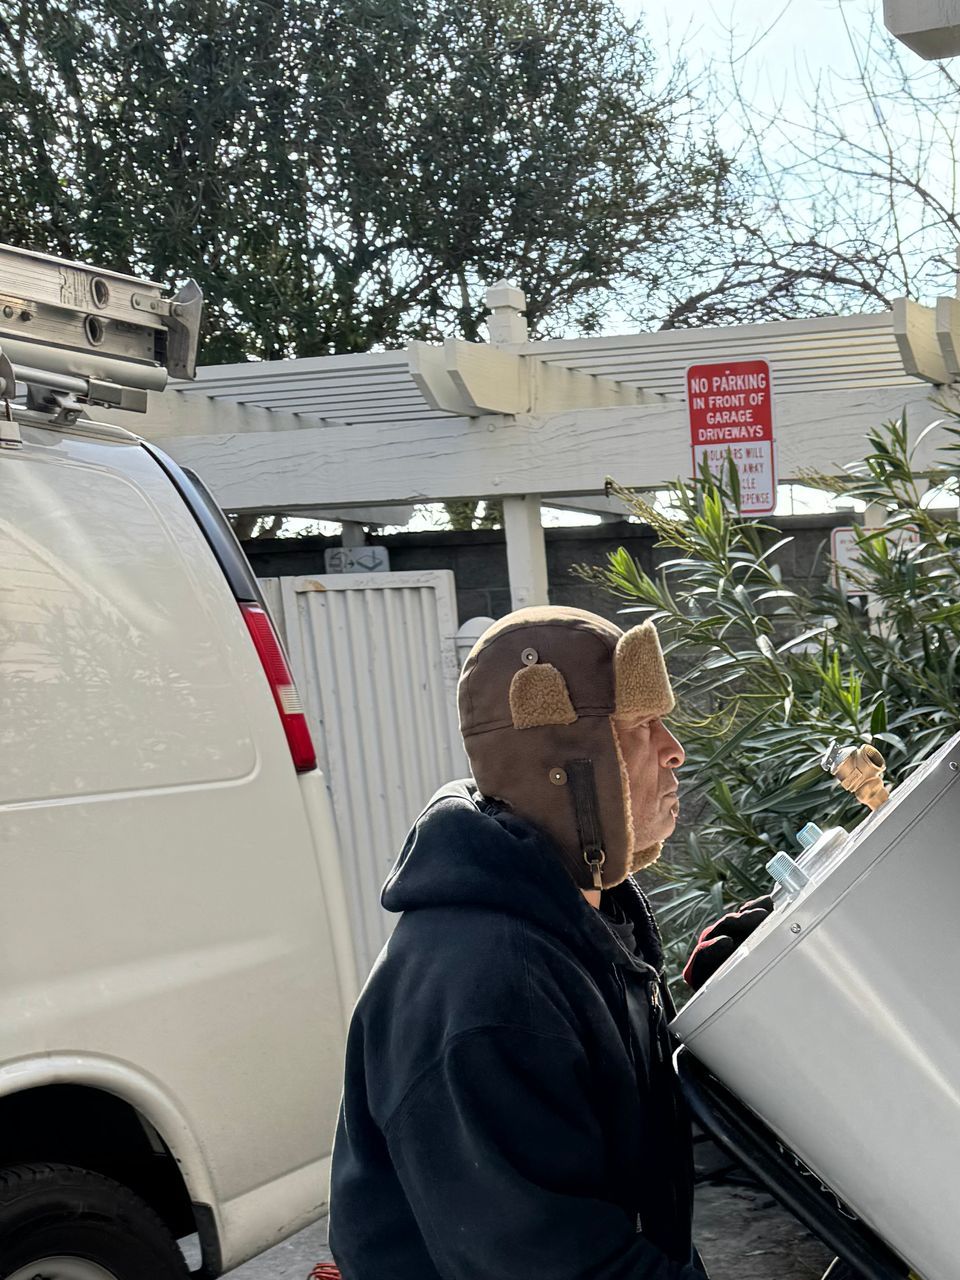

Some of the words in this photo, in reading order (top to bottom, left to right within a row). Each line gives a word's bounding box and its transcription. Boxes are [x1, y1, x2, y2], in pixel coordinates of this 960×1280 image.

[691, 378, 708, 394] NO
[713, 373, 766, 392] PARKING
[693, 397, 705, 410] IN
[708, 394, 746, 409] FRONT
[749, 392, 765, 406] OF
[706, 409, 754, 425] GARAGE
[698, 424, 764, 441] DRIVEWAYS
[746, 447, 764, 459] WILL
[743, 463, 764, 473] AWAY
